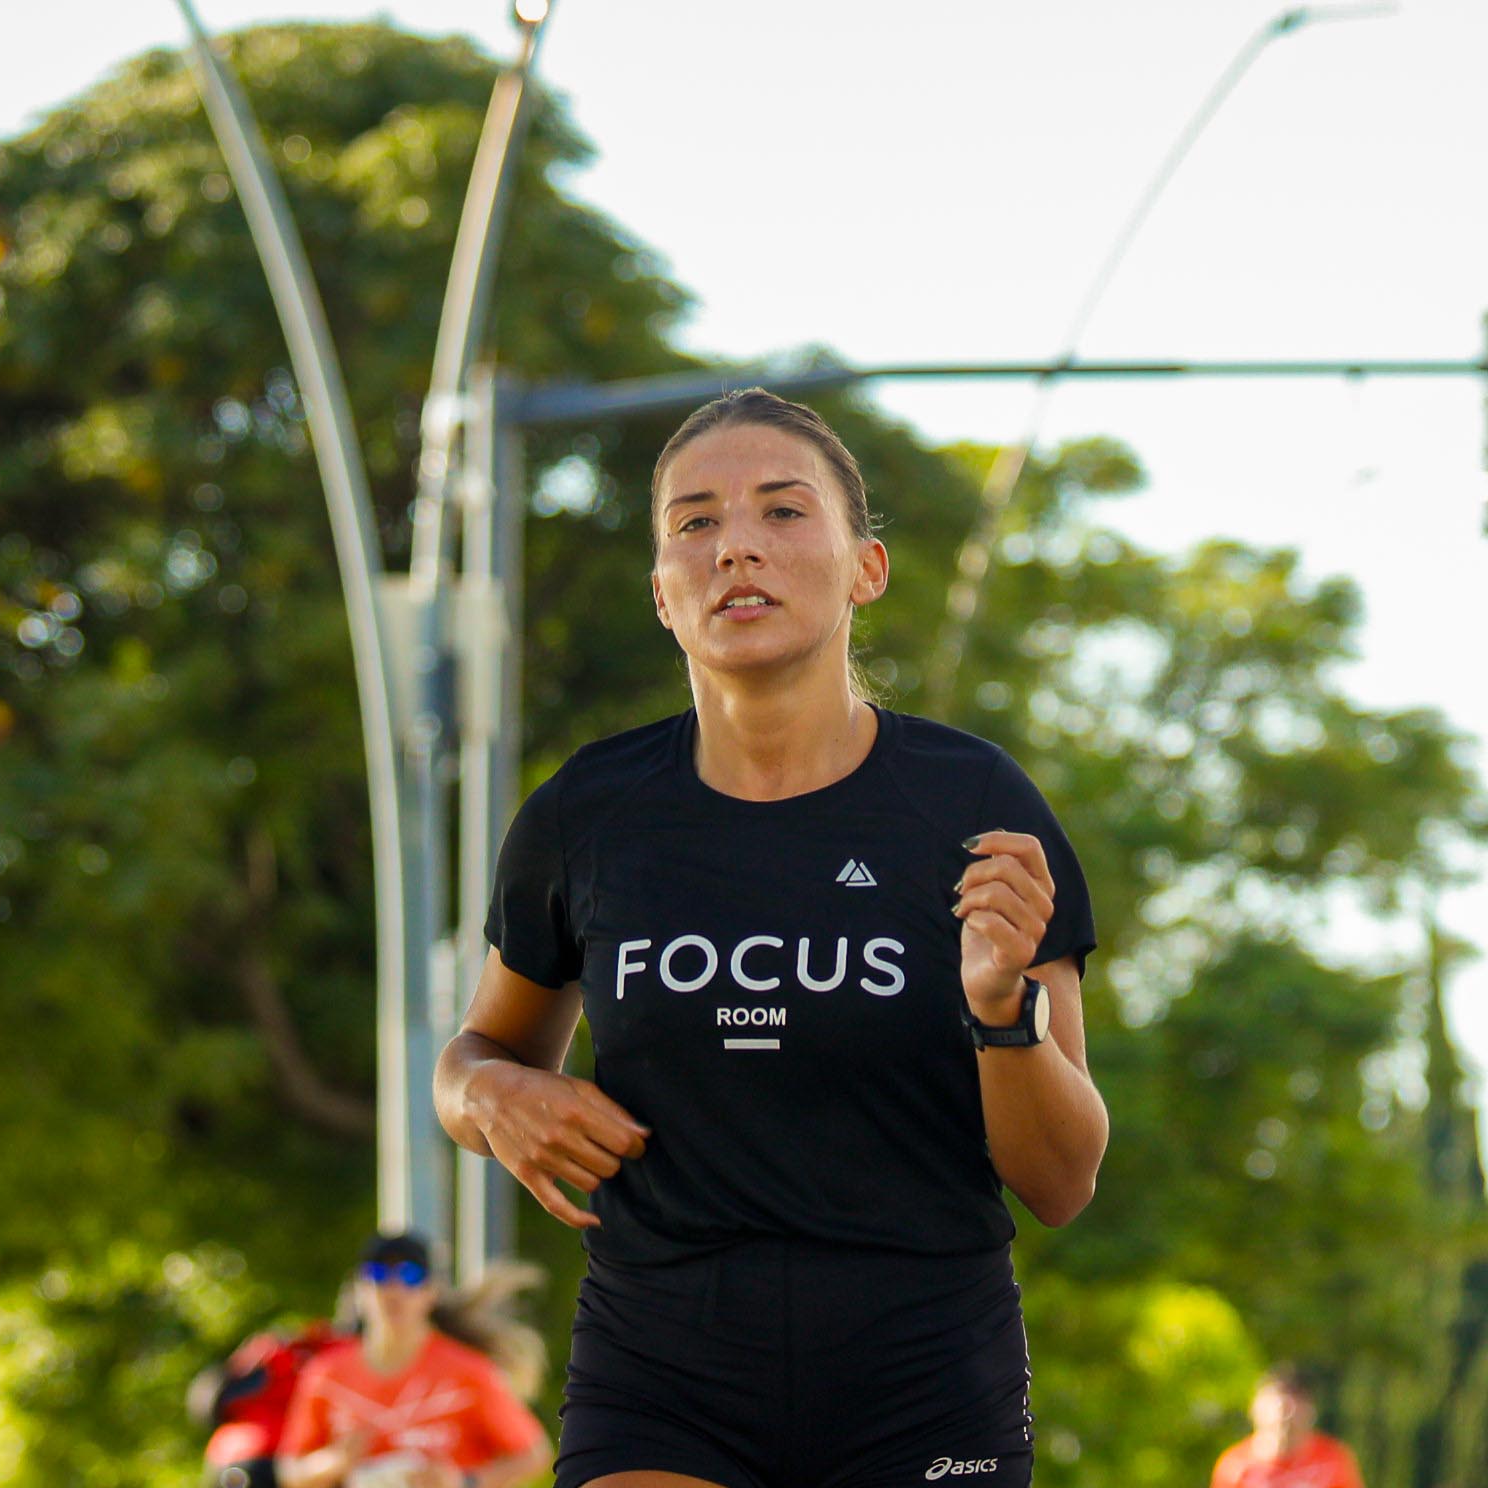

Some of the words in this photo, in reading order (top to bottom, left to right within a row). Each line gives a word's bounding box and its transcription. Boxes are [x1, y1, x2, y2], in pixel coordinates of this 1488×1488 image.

[616, 934, 906, 1000] FOCUS
[716, 1007, 787, 1026] ROOM
[951, 1457, 999, 1475] asics
